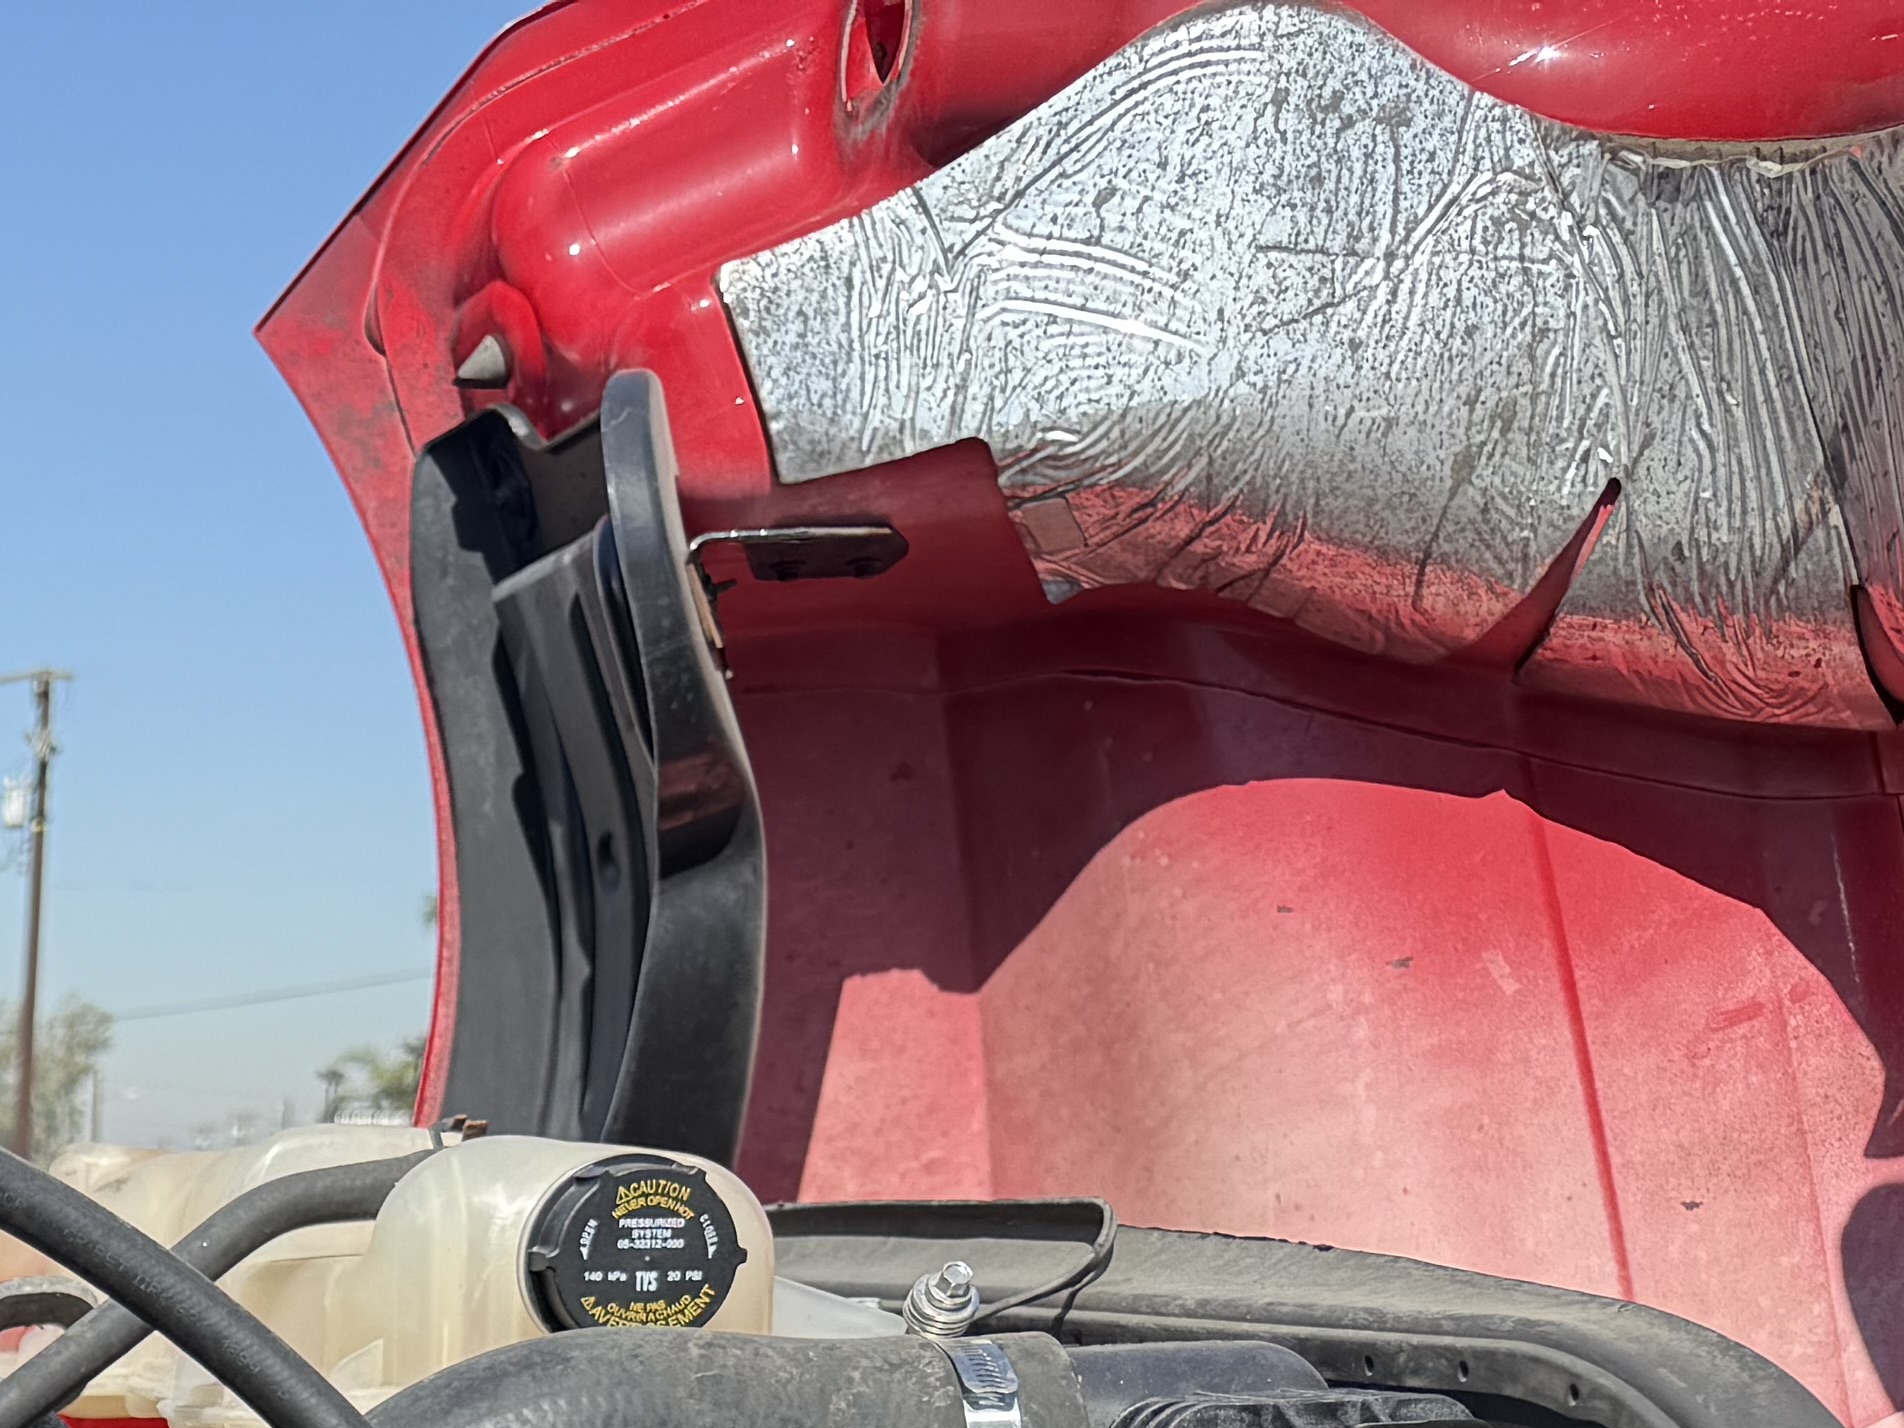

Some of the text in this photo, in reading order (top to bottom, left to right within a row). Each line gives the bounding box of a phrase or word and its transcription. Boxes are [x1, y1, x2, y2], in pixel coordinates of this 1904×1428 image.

[629, 1180, 691, 1200] CAUTION
[612, 1196, 695, 1220] NEVER OPEN HOT
[618, 1218, 685, 1228] PRESSURIZED
[580, 1219, 600, 1245] OPEN
[631, 1229, 672, 1239] SYSTEM
[584, 1271, 603, 1281] 140
[635, 1272, 658, 1292] TVS
[666, 1271, 702, 1280] 20 PSI
[629, 1300, 666, 1311] NE PAS
[654, 1294, 692, 1321] CHAUD
